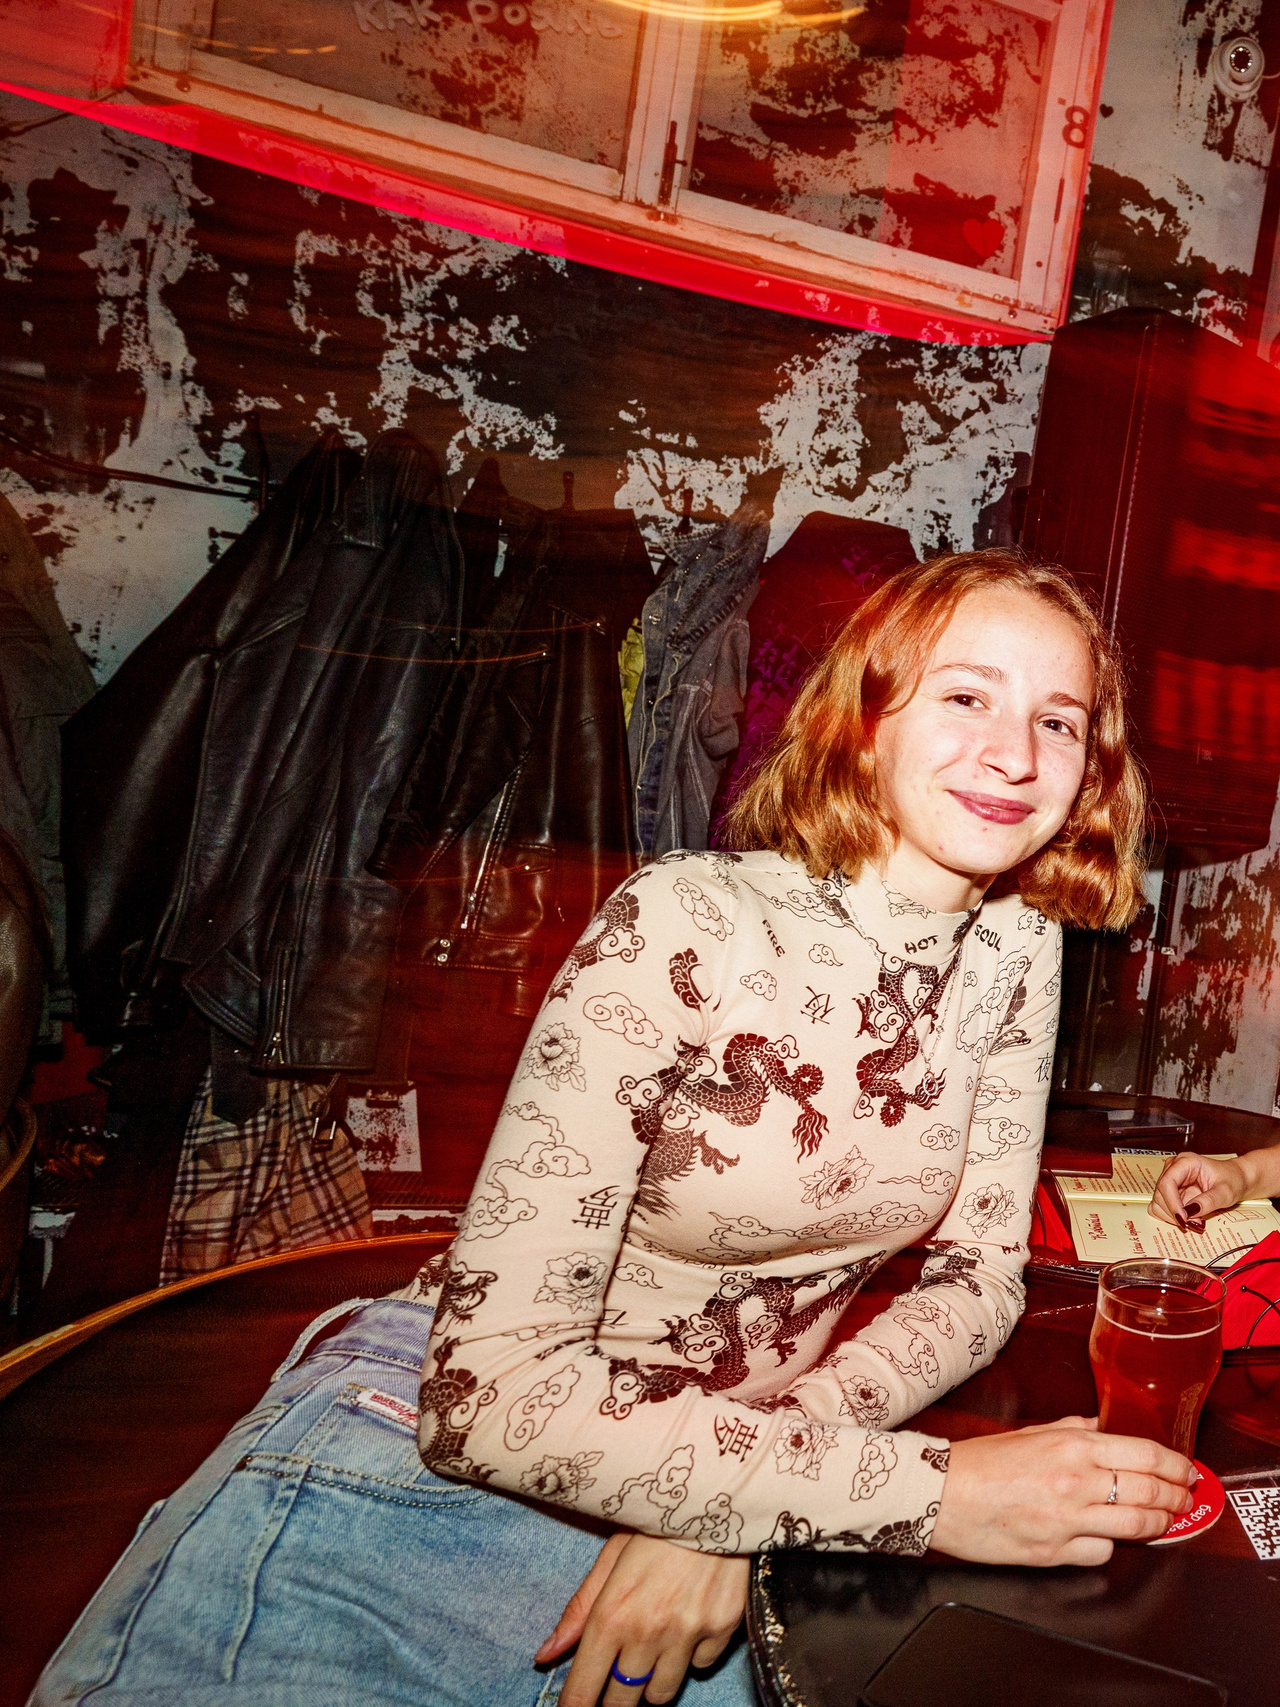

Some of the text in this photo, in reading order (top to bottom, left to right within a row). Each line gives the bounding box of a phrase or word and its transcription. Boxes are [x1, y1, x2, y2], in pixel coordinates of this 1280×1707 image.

[1034, 907, 1048, 936] HO
[762, 919, 786, 958] FIRE
[904, 935, 939, 954] HOT
[975, 923, 1002, 952] SOUL
[1034, 1052, 1053, 1083] 夜
[1189, 1503, 1213, 1522] бар
